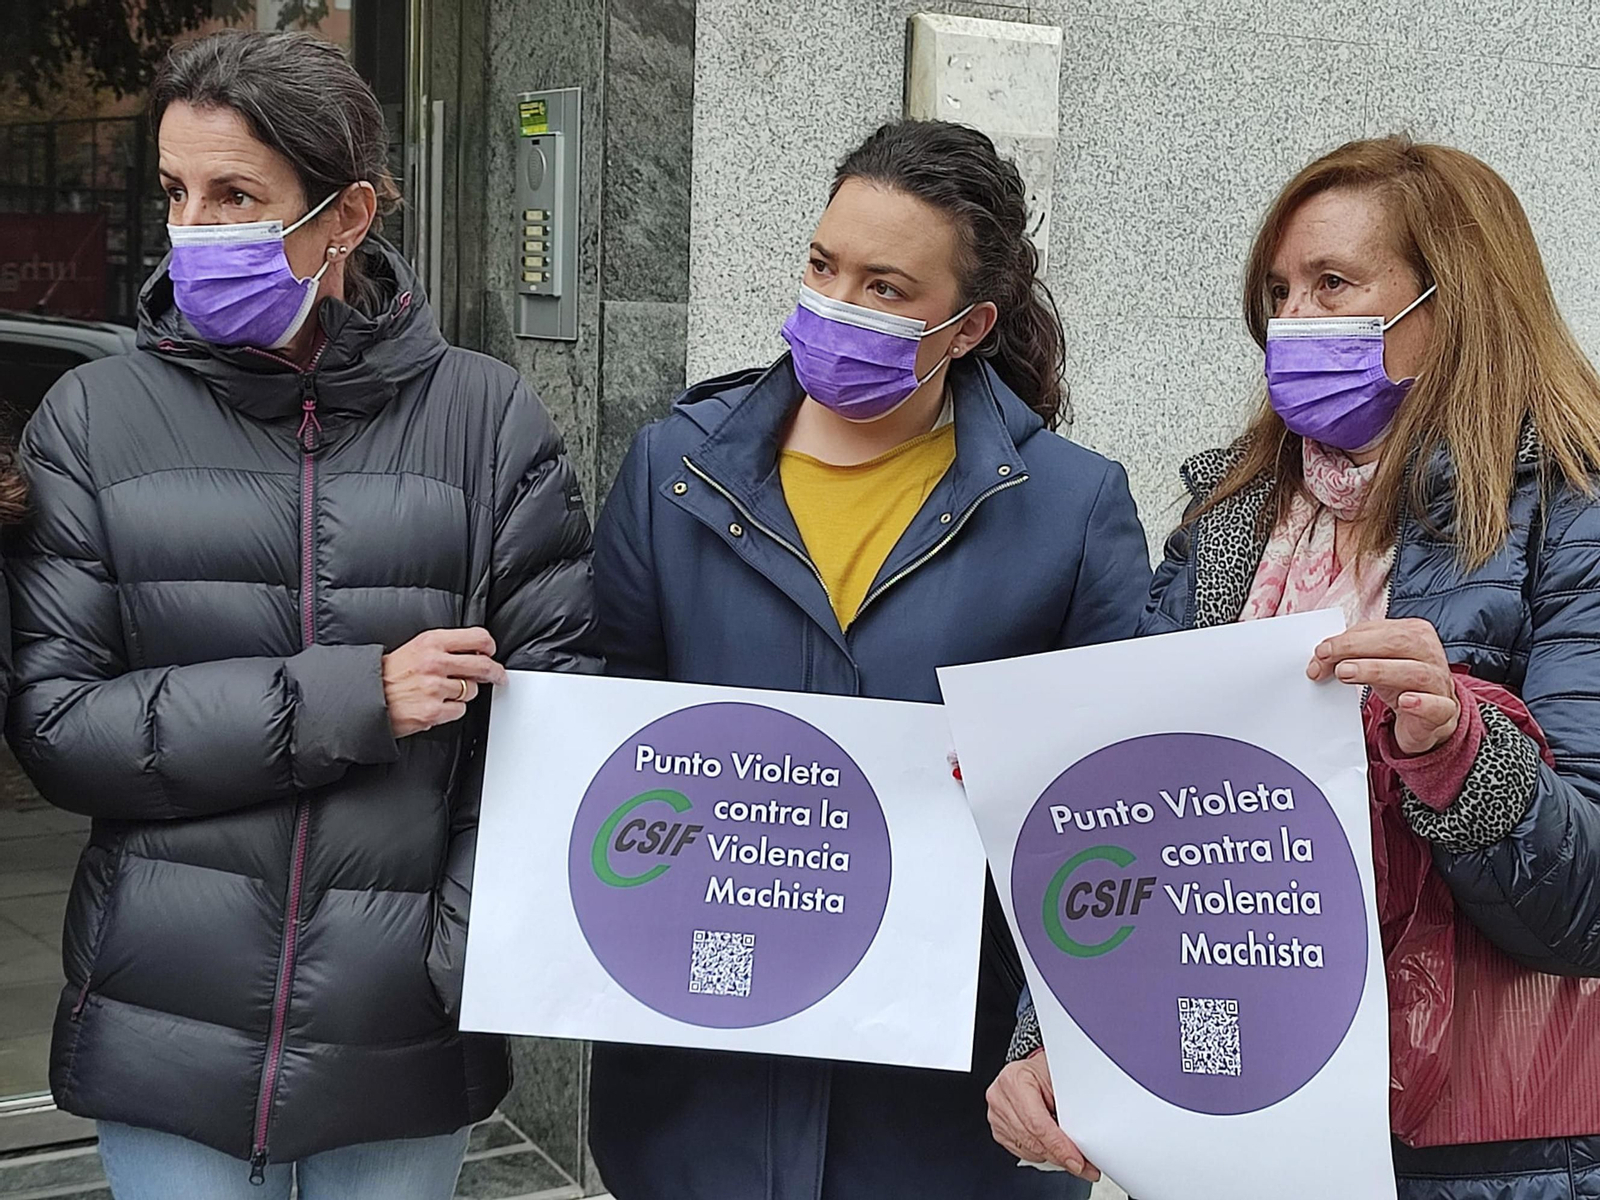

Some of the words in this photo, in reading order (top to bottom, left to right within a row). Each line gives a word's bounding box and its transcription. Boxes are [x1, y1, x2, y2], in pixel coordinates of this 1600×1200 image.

[635, 744, 722, 778] Punto
[731, 752, 840, 787] Violeta
[713, 800, 811, 826] contra
[820, 799, 849, 829] la
[1049, 799, 1155, 834] Punto
[1159, 780, 1295, 818] Violeta
[614, 818, 704, 857] CSIF
[707, 834, 850, 872] Violencia
[1161, 835, 1273, 867] contra
[1280, 826, 1313, 862] la
[704, 876, 845, 914] Machista
[1065, 876, 1157, 920] CSIF
[1163, 878, 1322, 915] Violencia
[1180, 930, 1324, 968] Machista
